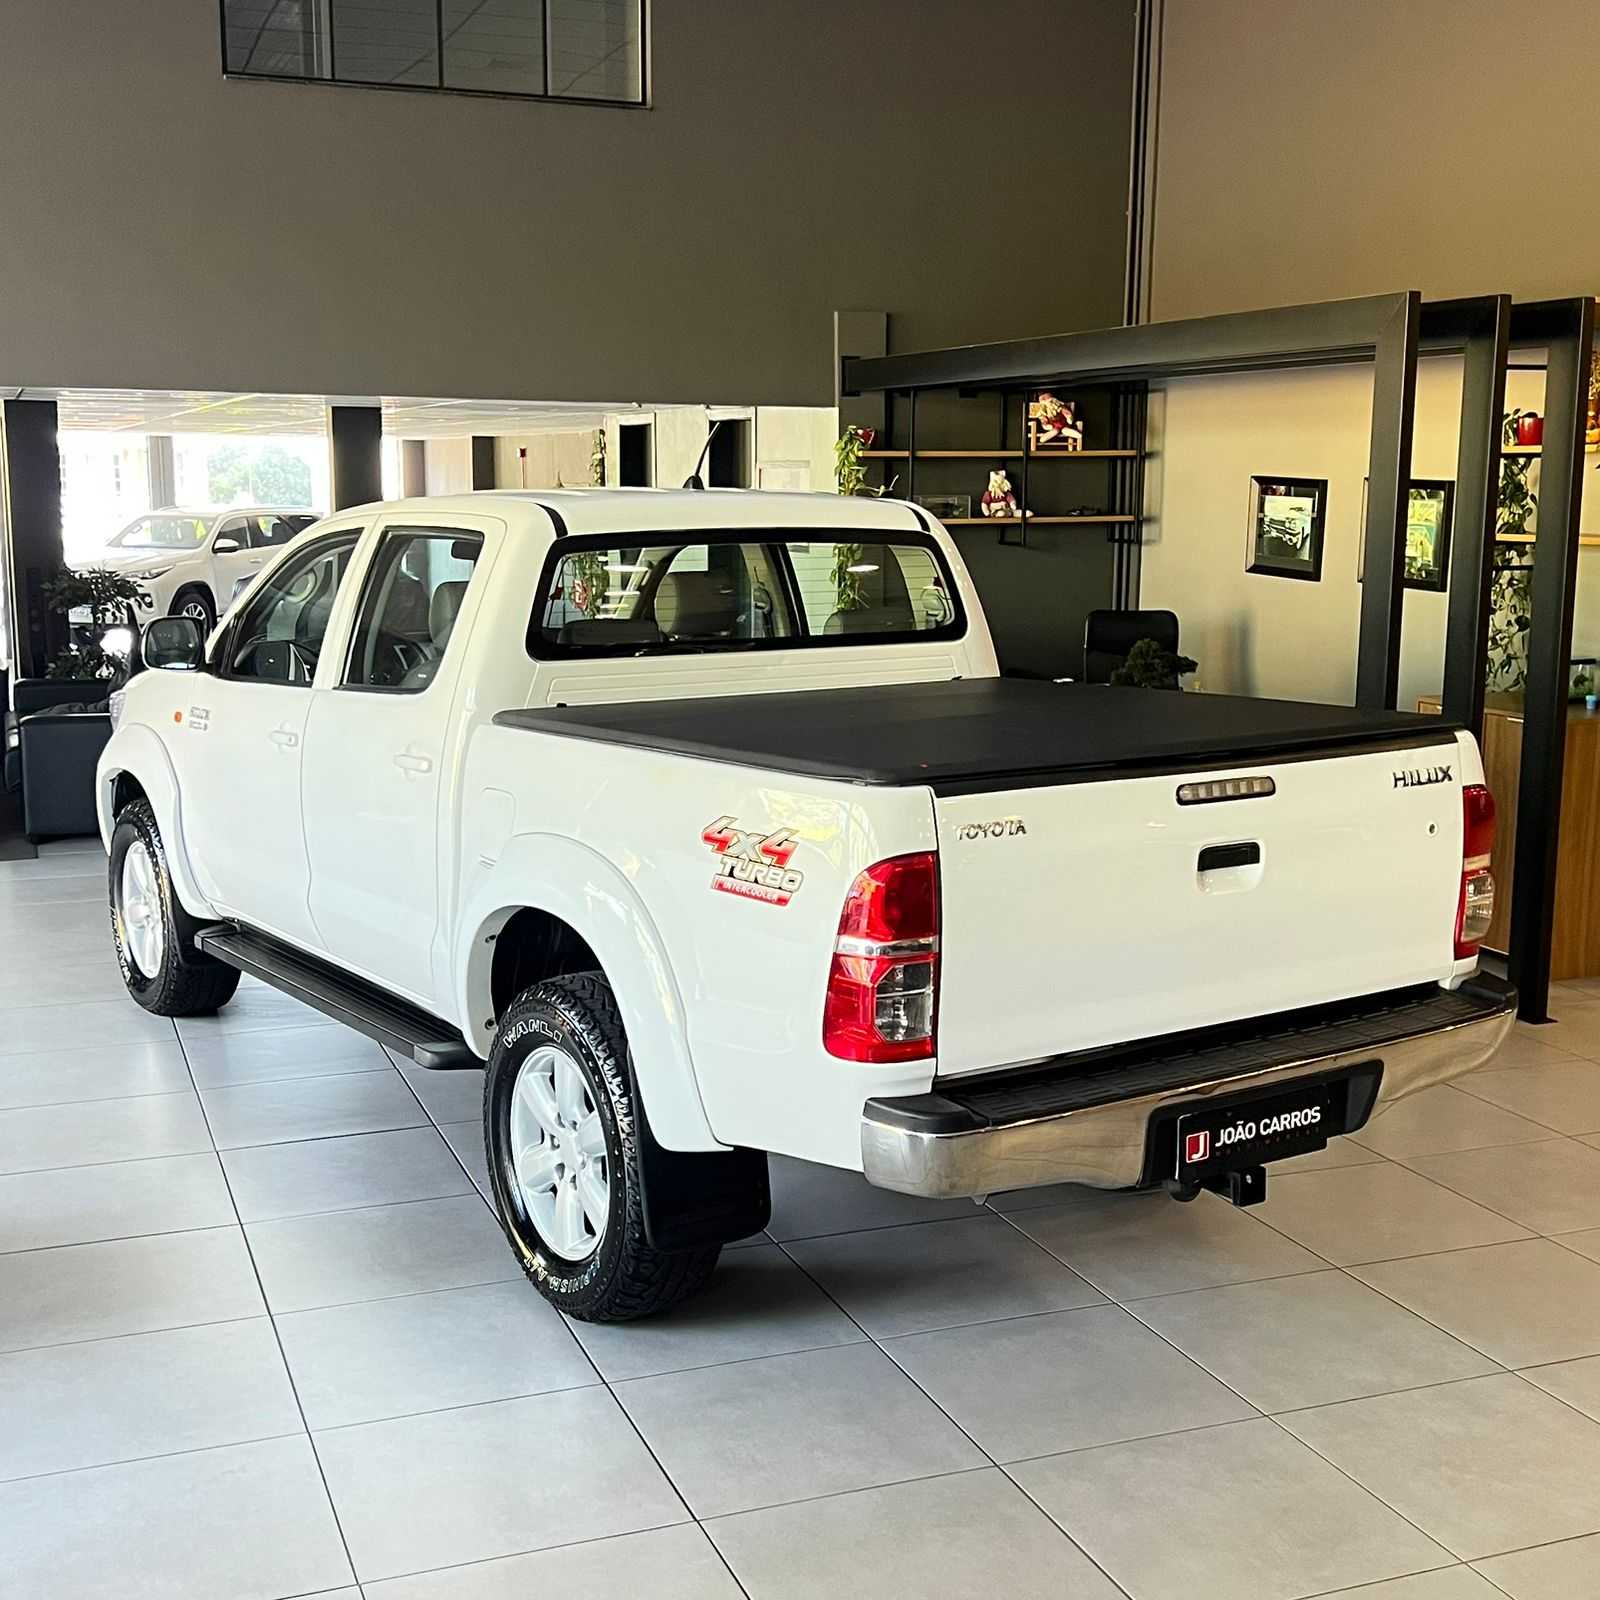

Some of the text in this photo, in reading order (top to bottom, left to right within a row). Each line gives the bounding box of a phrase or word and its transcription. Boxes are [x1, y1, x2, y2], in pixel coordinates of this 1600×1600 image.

[1392, 765, 1453, 789] HILUX
[958, 819, 1027, 841] TOYOTA
[719, 856, 804, 893] TURBO
[503, 1019, 563, 1049] WANLI
[1215, 1120, 1256, 1147] JOÃO
[1259, 1106, 1321, 1136] CARROS
